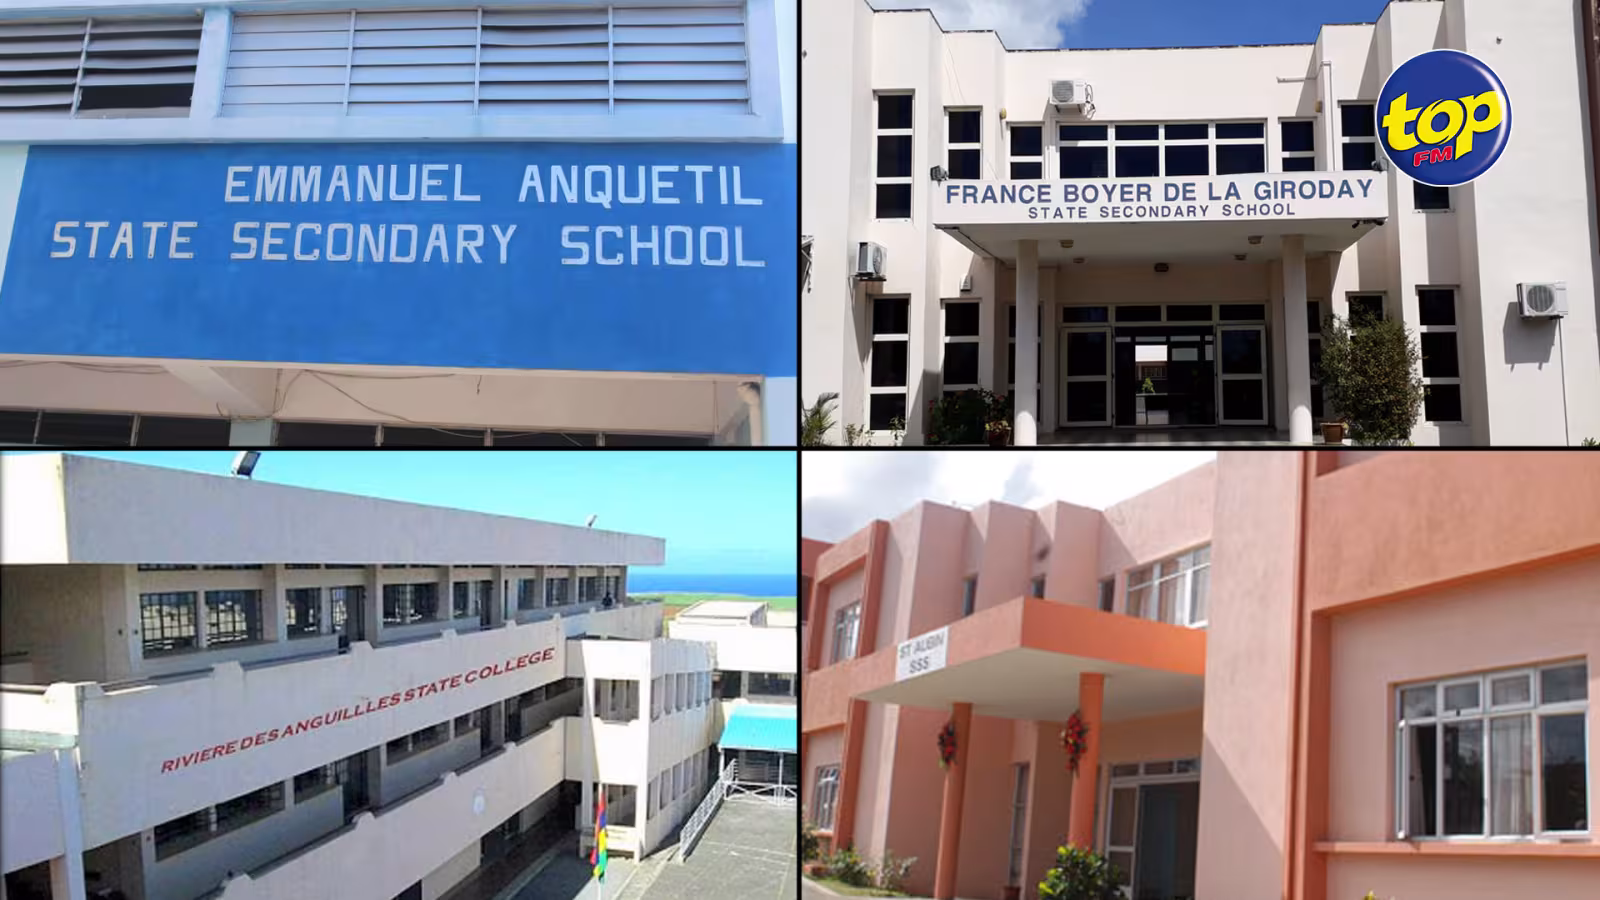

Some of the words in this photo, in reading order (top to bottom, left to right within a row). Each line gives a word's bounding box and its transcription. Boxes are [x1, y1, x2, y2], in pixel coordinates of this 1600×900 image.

[224, 164, 481, 202] EMMANUEL
[518, 165, 763, 208] ANQUETIL
[946, 184, 1052, 204] FRANCE
[1064, 183, 1152, 203] BOYER
[1164, 182, 1197, 202] DE
[1208, 181, 1241, 201] LA
[1254, 178, 1373, 200] GIRODAY
[1028, 206, 1087, 219] STATE
[1099, 205, 1209, 218] SECONDARY
[1222, 203, 1295, 216] SCHOOL
[50, 221, 198, 259] STATE
[230, 222, 517, 264] SECONDARY
[561, 226, 766, 267] SCHOOL
[909, 656, 929, 674] SSS
[161, 740, 238, 773] RIVIERE
[240, 729, 280, 750] DES
[280, 692, 401, 738] ANGUILLLES
[403, 674, 463, 702] STATE
[464, 647, 555, 684] COLLEGE
